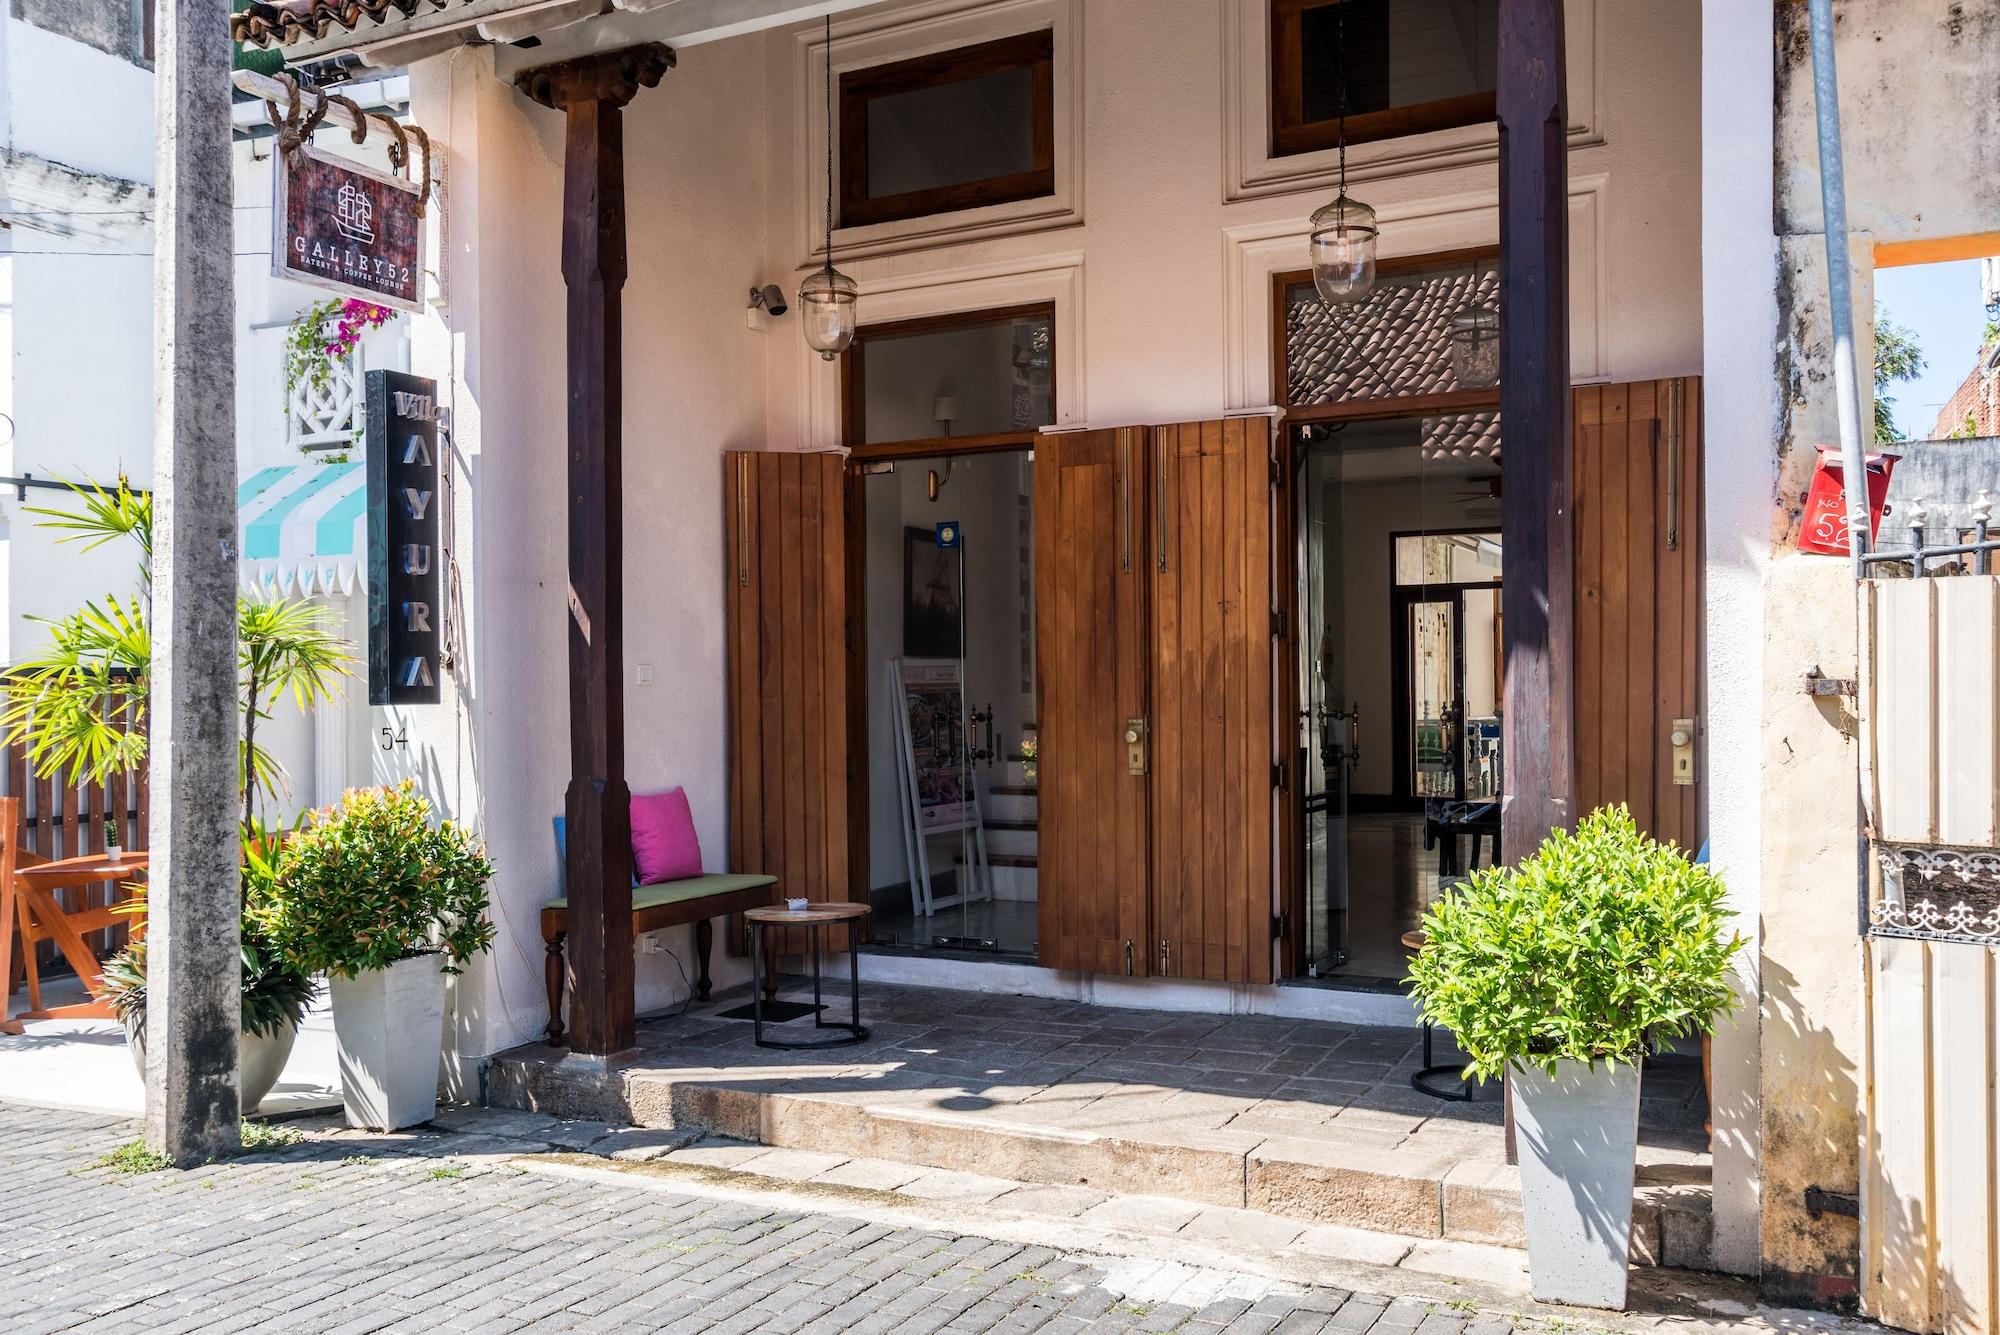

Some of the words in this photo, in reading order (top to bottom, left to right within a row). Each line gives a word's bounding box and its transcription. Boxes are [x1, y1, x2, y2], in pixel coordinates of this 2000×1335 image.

[300, 256, 331, 271] EATERY
[343, 268, 372, 281] COFFEE
[375, 277, 404, 290] LOUNGE
[382, 727, 408, 751] 54
